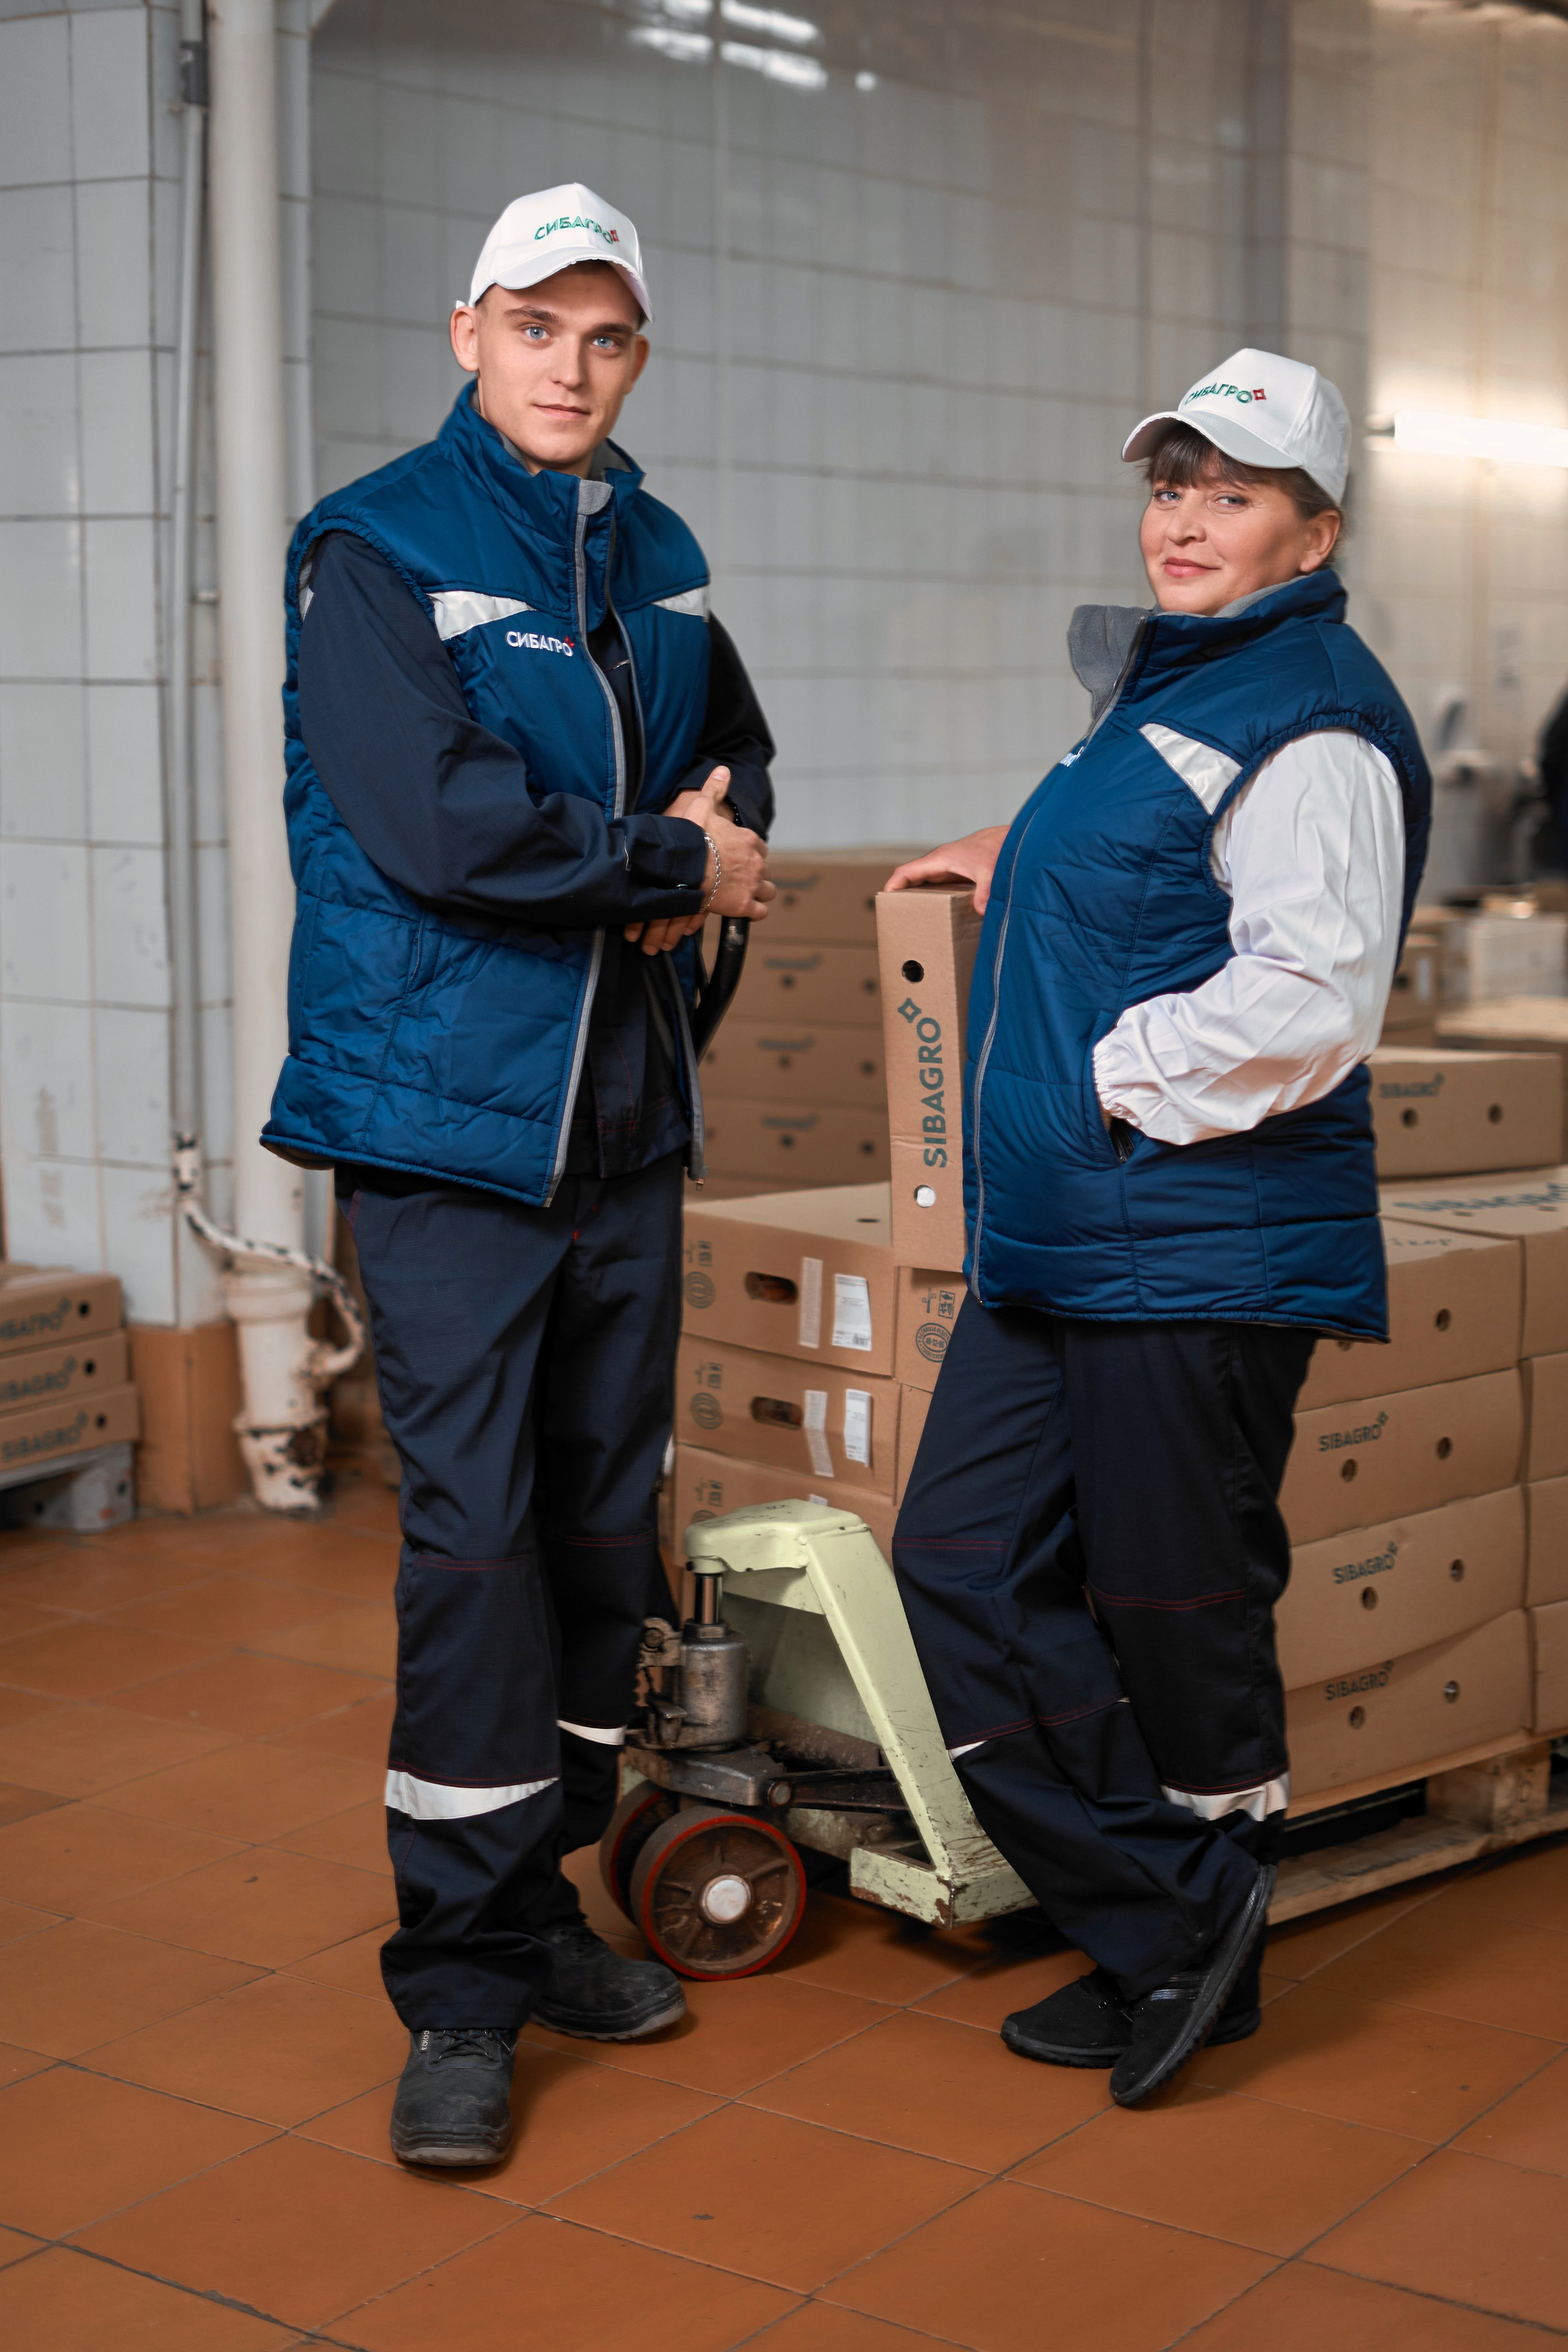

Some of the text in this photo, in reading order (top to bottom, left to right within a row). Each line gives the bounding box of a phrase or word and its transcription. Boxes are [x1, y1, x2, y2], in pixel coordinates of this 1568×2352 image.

[535, 216, 612, 244] СИБАГРО
[1185, 383, 1253, 405] СИБАГРО
[507, 631, 573, 657] СИБАГРО
[916, 1017, 947, 1169] SIBAGRO
[1319, 1423, 1382, 1452] SIBAGRO
[1333, 1553, 1395, 1585] SIBAGRO
[1324, 1670, 1389, 1701] SIBAGRO
